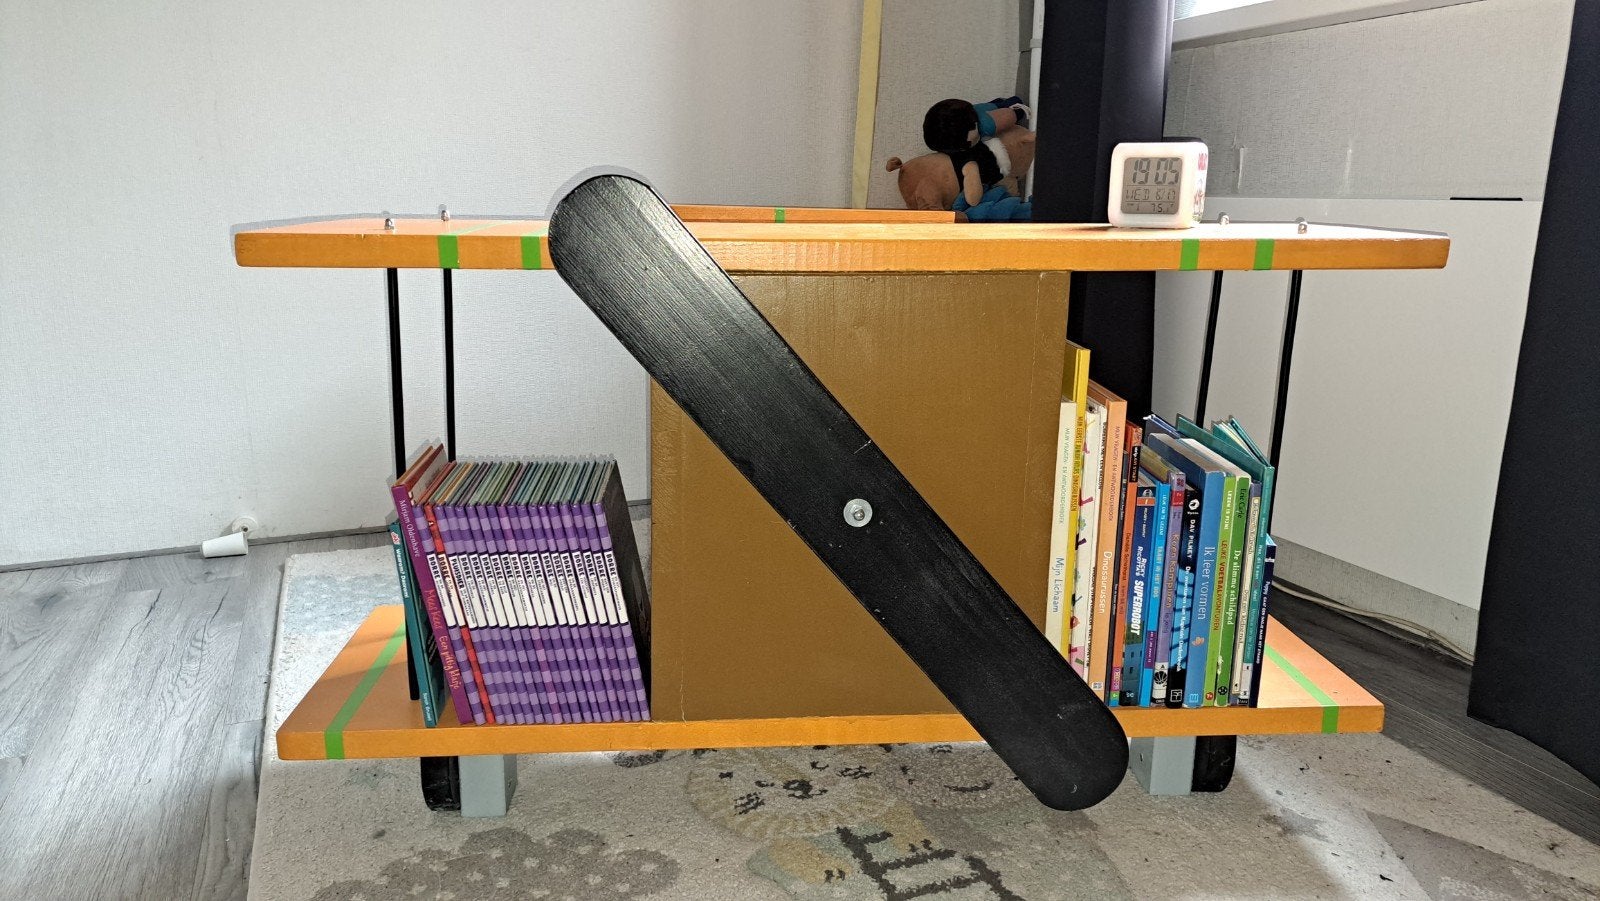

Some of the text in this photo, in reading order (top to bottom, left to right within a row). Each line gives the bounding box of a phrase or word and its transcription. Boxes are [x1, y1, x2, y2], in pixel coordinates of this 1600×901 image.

[398, 499, 422, 558] Mirjam Oldenhave
[1188, 519, 1196, 533] DAV
[1170, 533, 1179, 558] Koen
[1186, 535, 1194, 559] PILKEY
[1219, 540, 1228, 560] LEUKE
[428, 556, 441, 579] BORRE
[438, 556, 451, 579] BORRE
[450, 558, 465, 589] PLUISDIER
[460, 557, 472, 580] BORRE
[471, 556, 483, 579] BORRE
[481, 556, 494, 579] BORRE
[491, 557, 504, 580] BORRE
[501, 556, 514, 579] BORRE
[510, 556, 522, 579] BORRE
[521, 556, 534, 579] BORRE
[530, 556, 543, 579] BORRE
[542, 555, 554, 578] BORRE
[552, 555, 564, 578] BORRE
[562, 555, 574, 578] BORRE
[573, 554, 585, 576] BORRE
[584, 554, 596, 576] BORRE
[595, 555, 607, 577] BORRE
[605, 553, 618, 576] BORRE
[1051, 557, 1064, 613] Mijn Lichaam
[1098, 551, 1113, 614] Dinosaurussen
[1164, 560, 1177, 609] Kampioen
[1197, 546, 1215, 620] Ik leer vormen
[1224, 550, 1241, 625] De slimme schildpad
[1129, 580, 1144, 636] SUPERROBOT
[438, 635, 451, 651] Een
